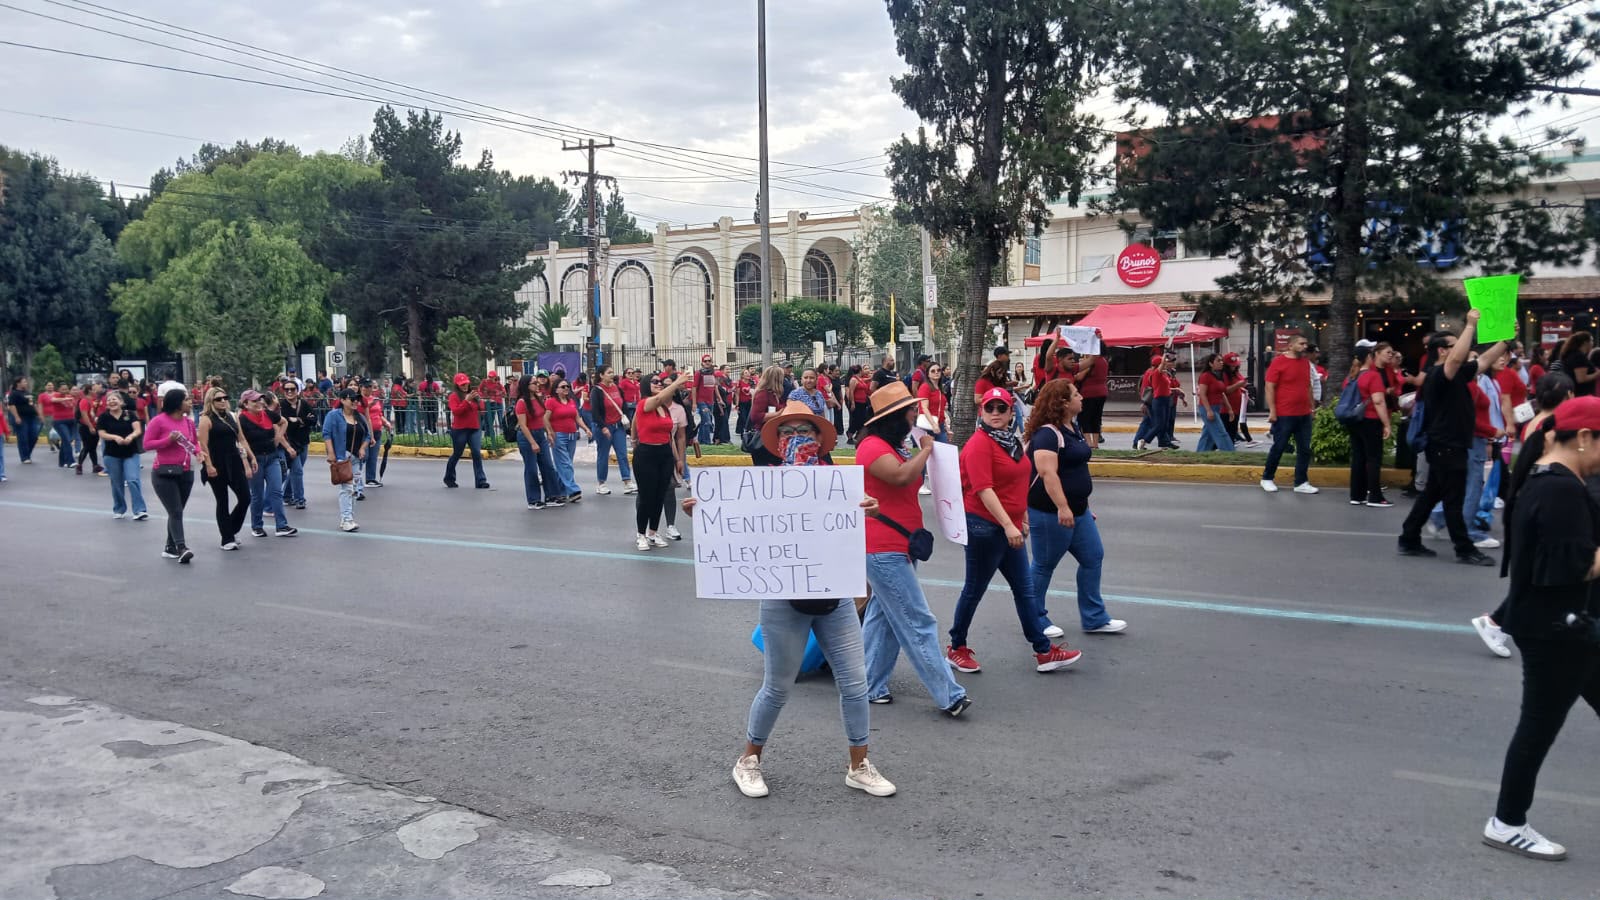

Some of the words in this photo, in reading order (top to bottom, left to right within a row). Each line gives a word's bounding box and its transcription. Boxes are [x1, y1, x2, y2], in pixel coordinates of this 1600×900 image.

[1119, 254, 1158, 271] Bruno's
[696, 469, 848, 503] CLAUDIA
[700, 506, 815, 536] MENTISTE
[822, 510, 858, 531] CON
[696, 543, 719, 563] LA
[728, 543, 760, 562] LEY
[768, 543, 809, 560] DEL
[712, 563, 833, 596] ISSSTE.
